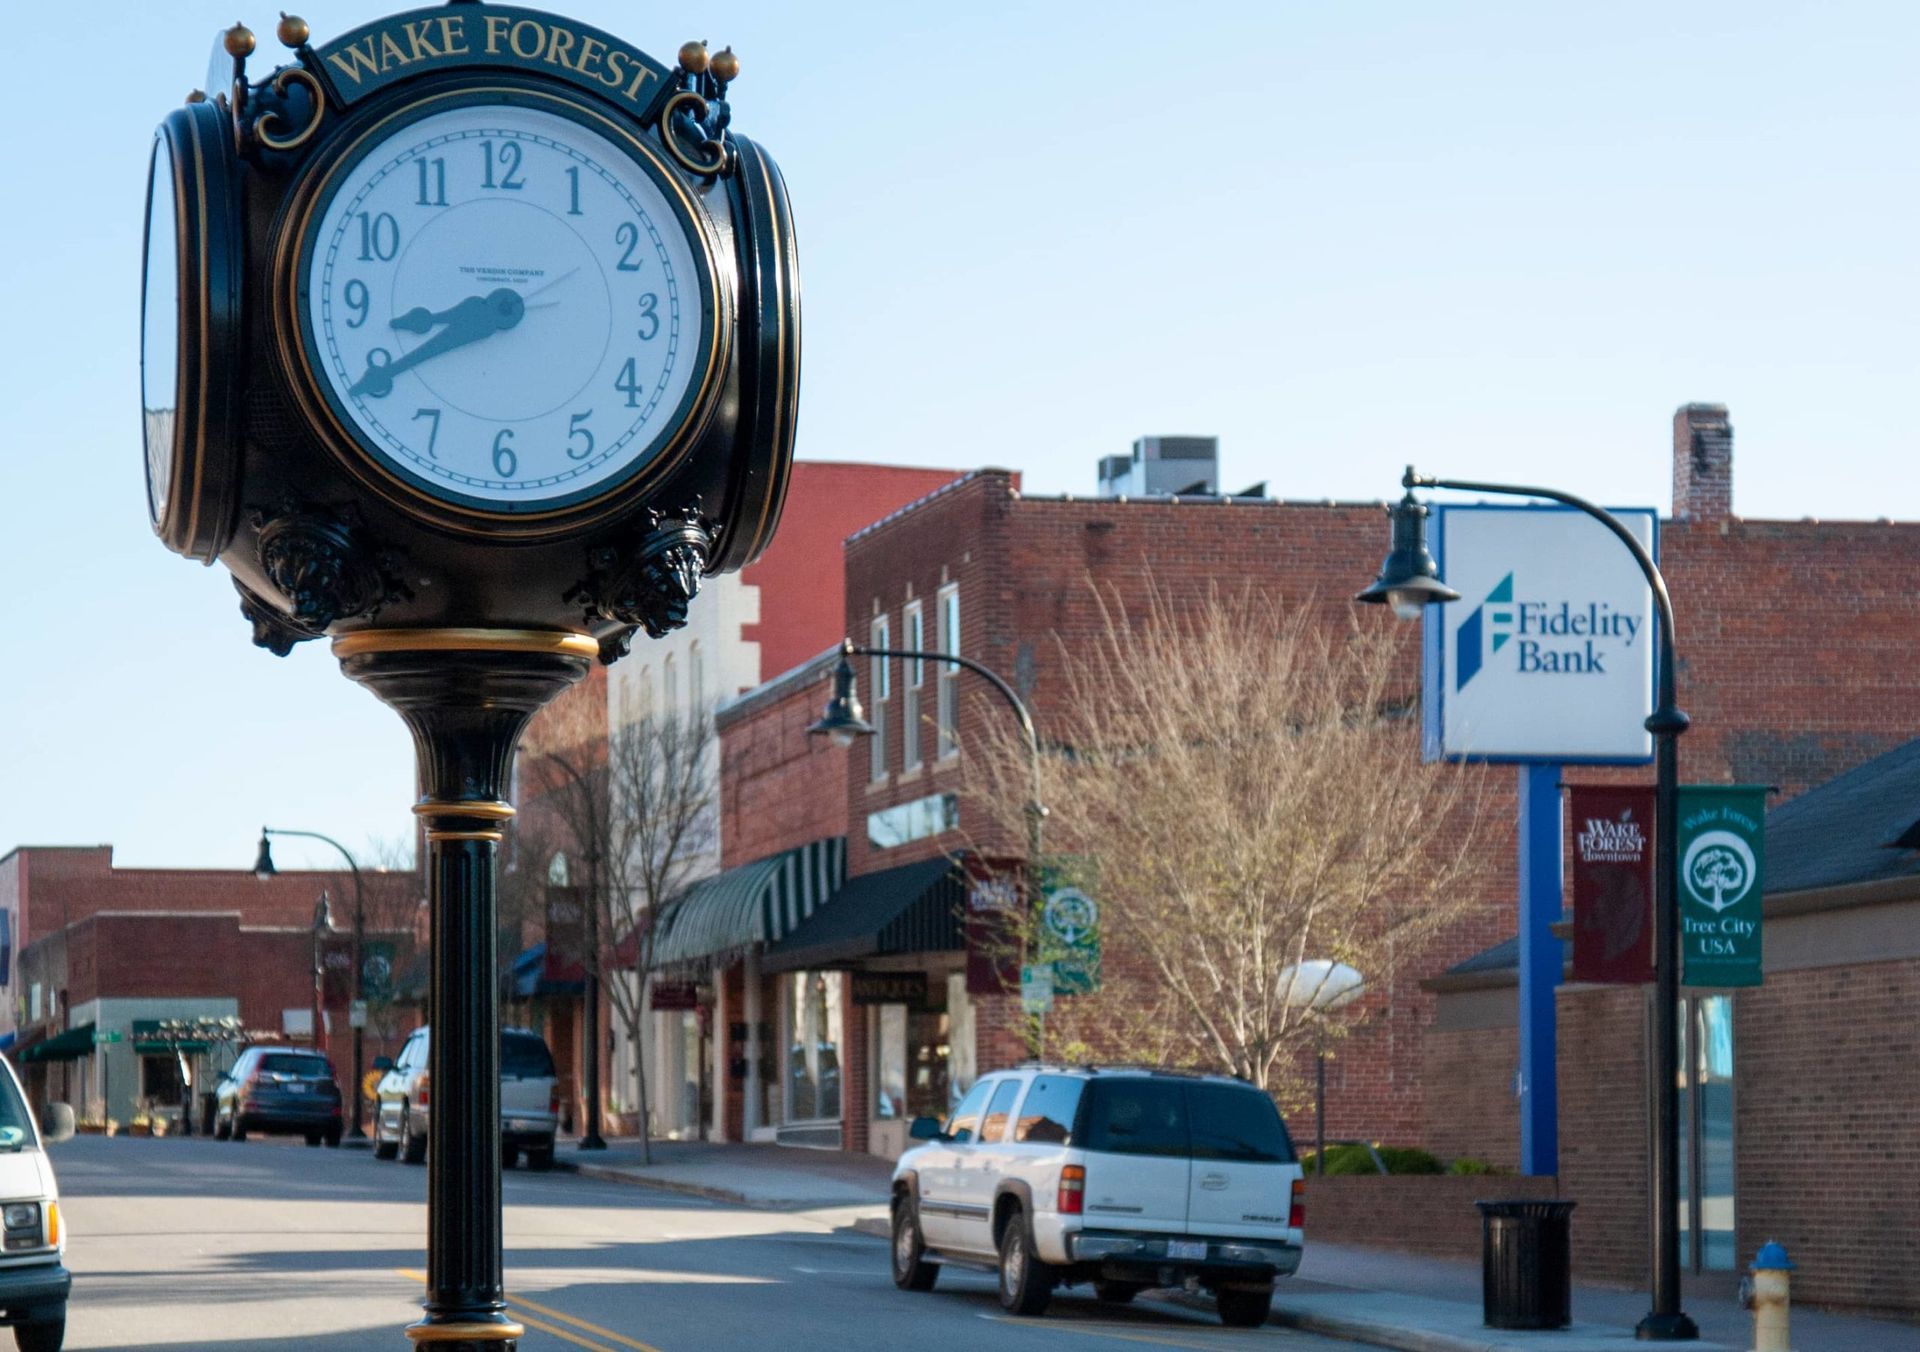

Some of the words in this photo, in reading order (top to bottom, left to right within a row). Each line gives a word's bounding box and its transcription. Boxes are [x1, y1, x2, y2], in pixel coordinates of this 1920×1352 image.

[328, 15, 469, 85] WAKE
[483, 15, 658, 102] FOREST
[413, 157, 450, 207] 11
[480, 139, 526, 190] 12
[565, 166, 584, 216] 1
[356, 212, 399, 261] 10
[615, 222, 642, 272] 2
[344, 279, 370, 328] 9
[637, 292, 660, 341] 3
[614, 357, 642, 408] 4
[411, 408, 441, 460] 7
[491, 429, 517, 479] 6
[566, 409, 594, 460] 5
[1518, 602, 1642, 647] Fidelity
[1518, 640, 1606, 674] Bank
[1578, 831, 1646, 852] FOREST
[1586, 818, 1639, 838] WAKE
[1683, 808, 1718, 831] Wake
[1722, 808, 1759, 832] Forest
[1583, 850, 1641, 862] downtown
[1684, 917, 1717, 934] Tree
[1721, 916, 1756, 938] City
[1701, 938, 1736, 954] USA
